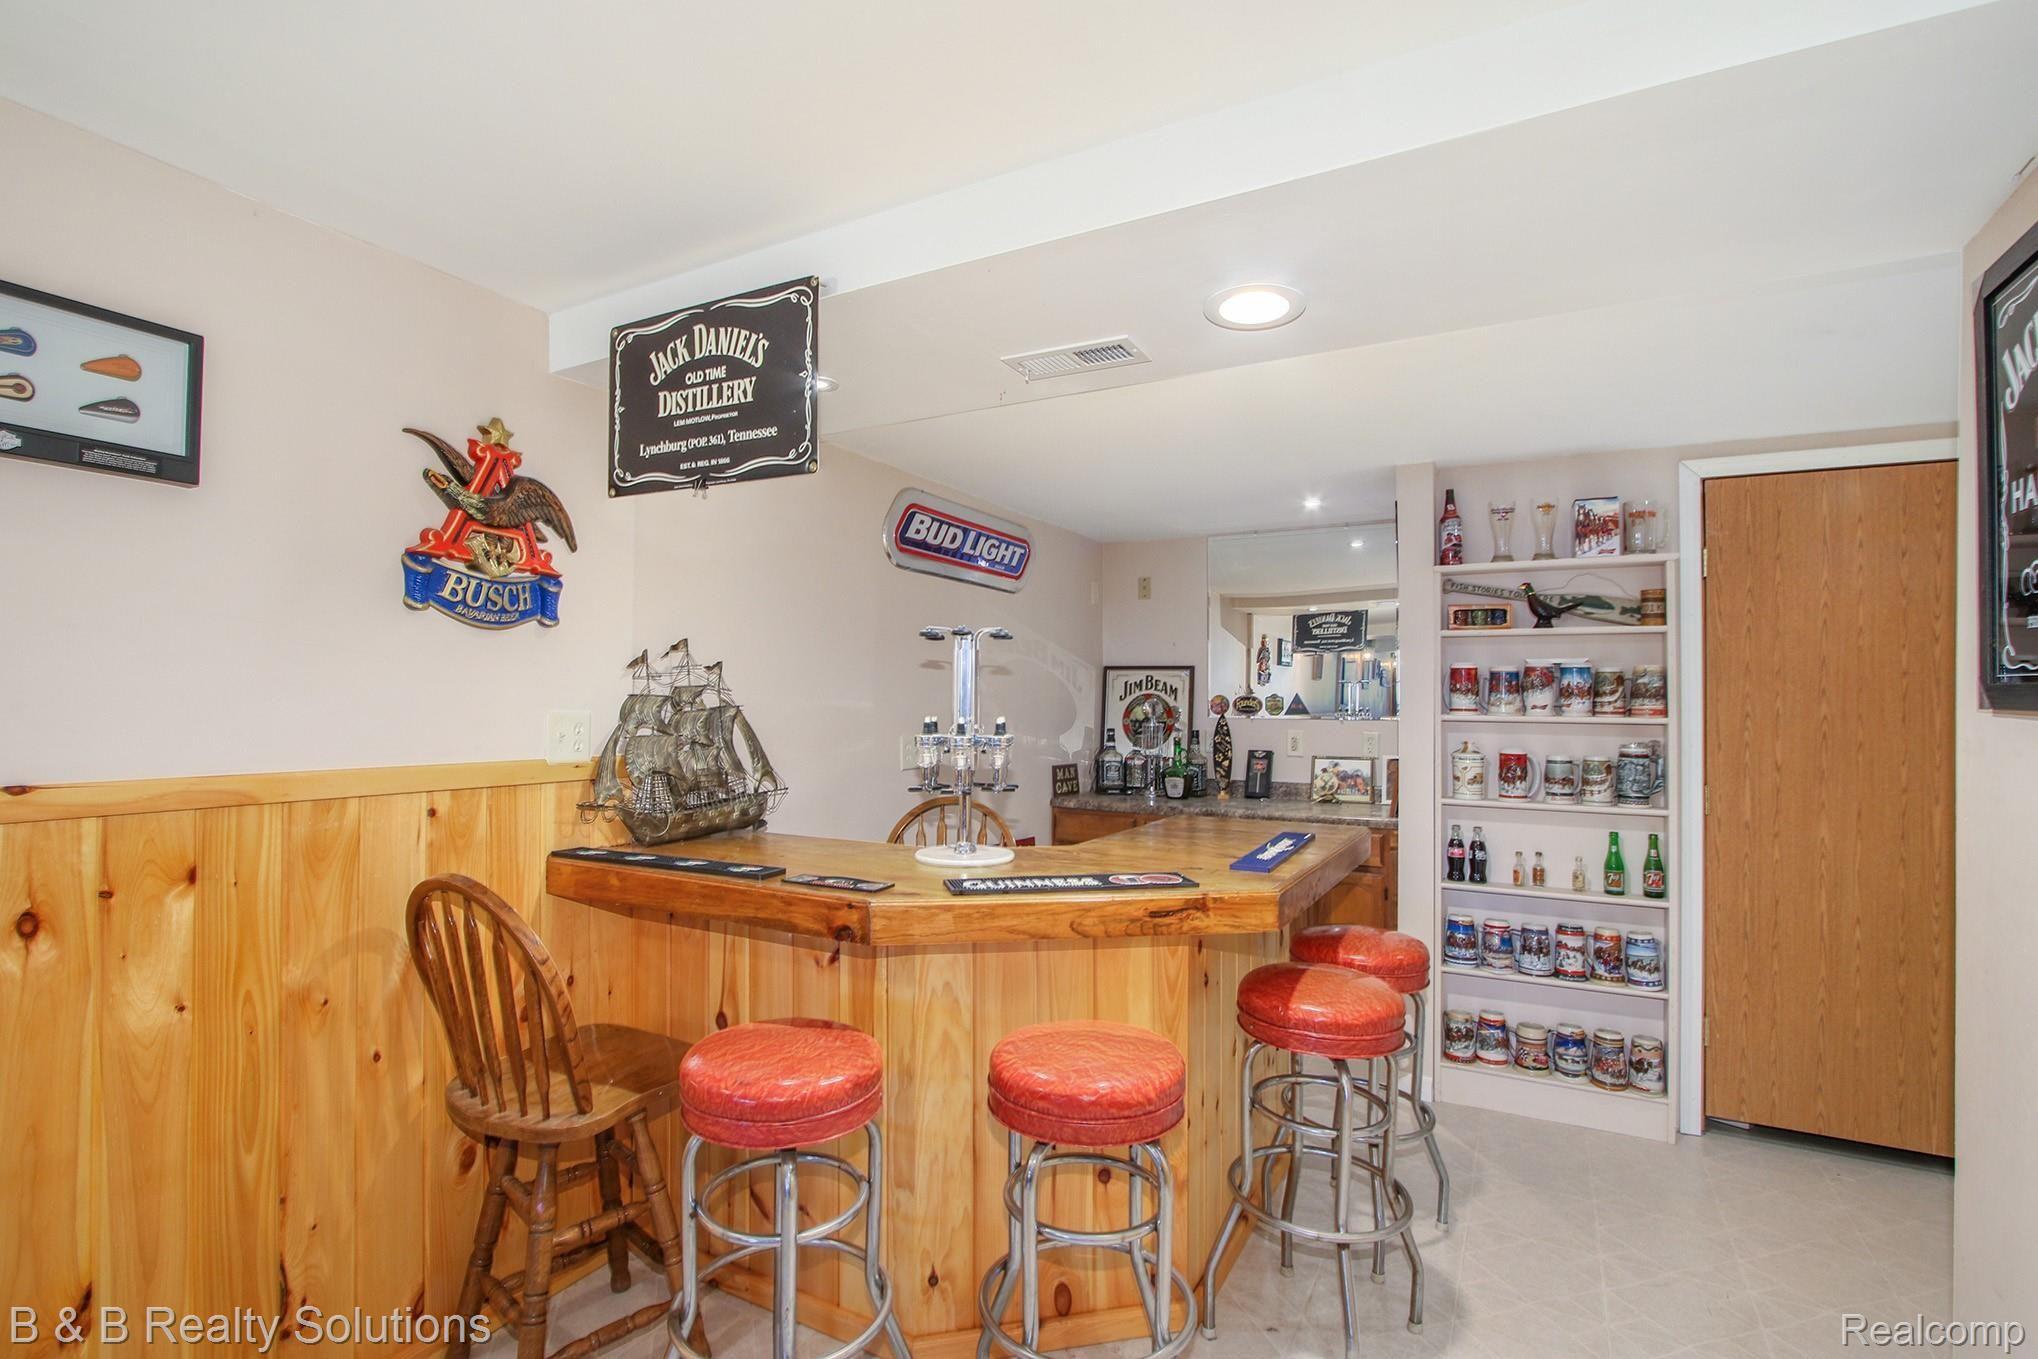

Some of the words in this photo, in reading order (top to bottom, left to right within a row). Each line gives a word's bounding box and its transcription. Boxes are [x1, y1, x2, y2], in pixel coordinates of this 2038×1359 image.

[649, 335, 693, 386] JACK
[693, 323, 770, 368] DANIEL'S
[685, 370, 704, 385] OLD
[705, 365, 727, 379] TIME
[657, 376, 757, 418] DISTILLERY
[639, 438, 687, 458] Lynchburg
[727, 425, 778, 443] Tennessee
[905, 513, 964, 549] BUD
[961, 530, 1025, 568] LIGHT
[436, 570, 533, 612] BUSCH
[1119, 679, 1145, 702] JIM
[1145, 674, 1178, 702] BEAM
